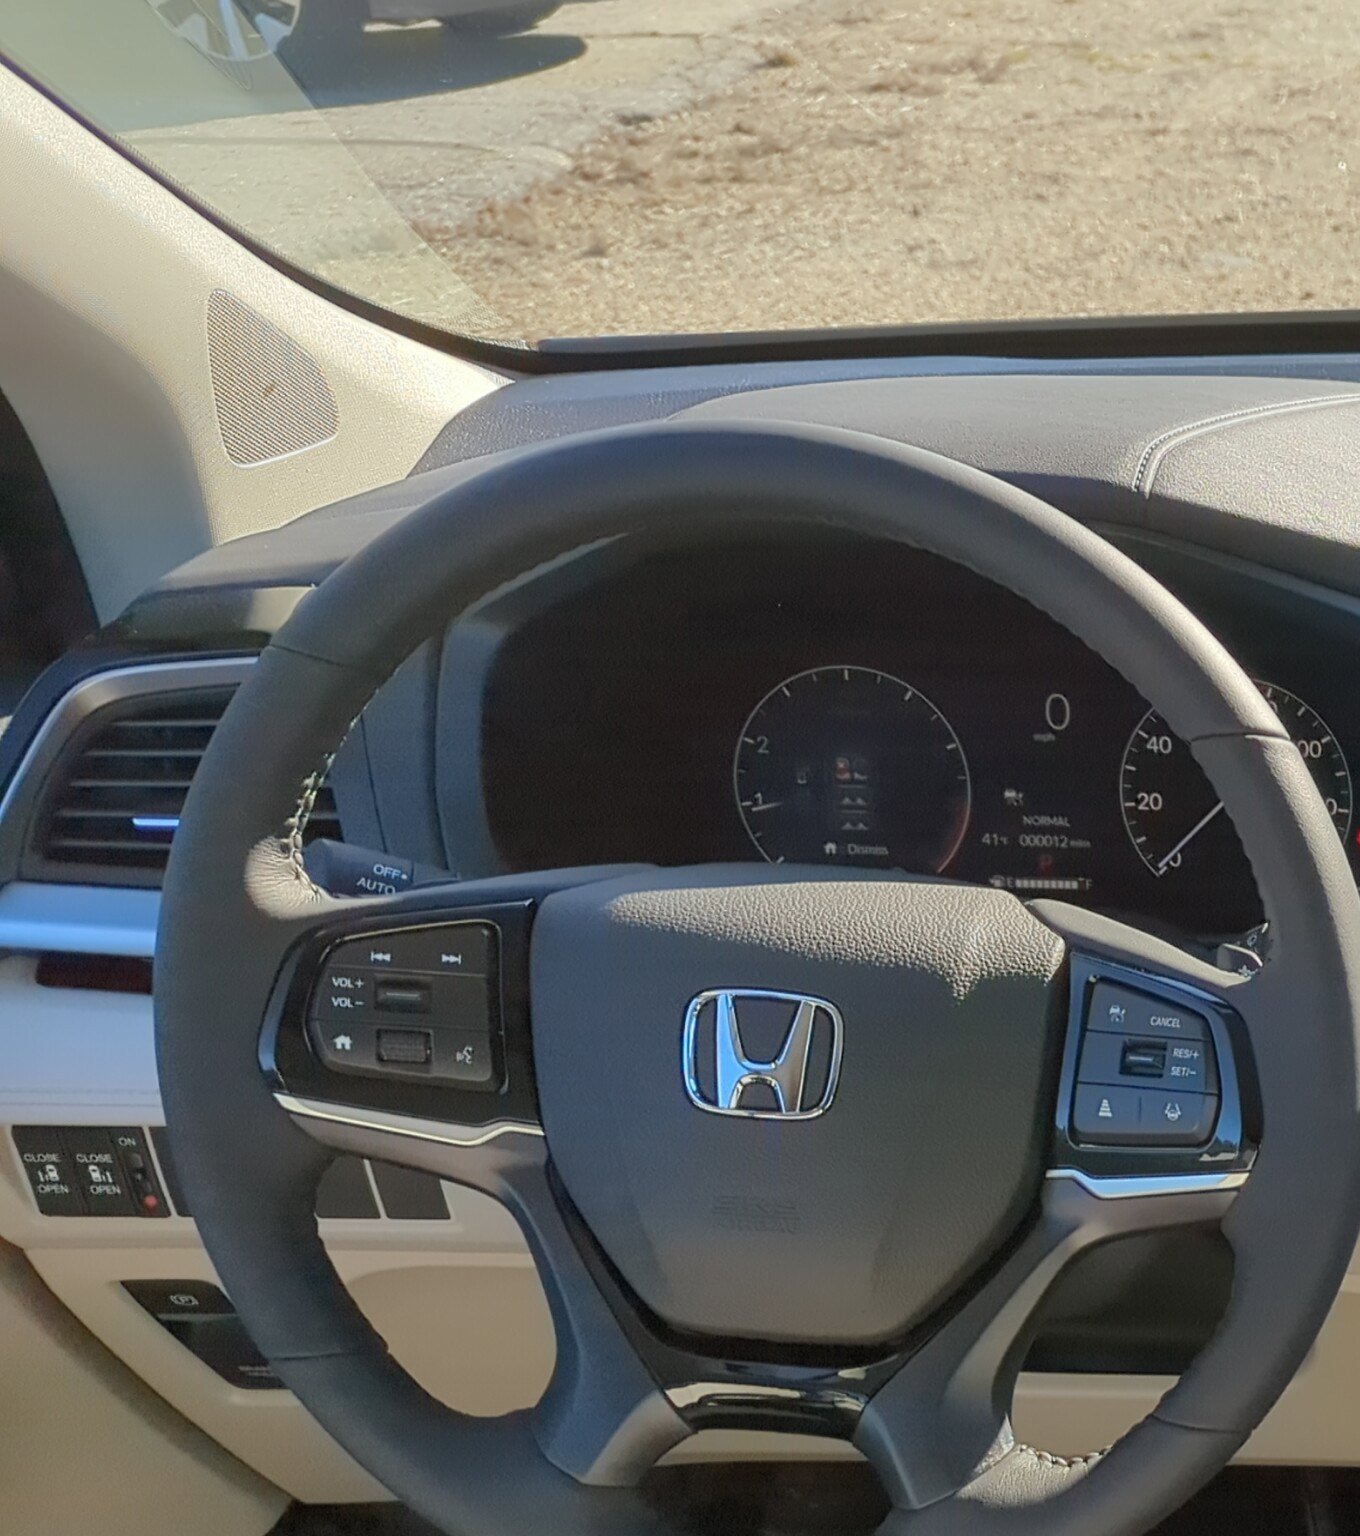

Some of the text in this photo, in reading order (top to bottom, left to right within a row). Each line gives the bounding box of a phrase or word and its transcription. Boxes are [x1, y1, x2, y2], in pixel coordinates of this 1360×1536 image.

[1045, 693, 1070, 730] 0
[757, 736, 769, 754] 2
[1147, 736, 1172, 754] 40
[1297, 740, 1322, 759] 00
[1137, 793, 1162, 811] 20
[1022, 815, 1070, 827] NORMAL
[1019, 834, 1069, 848] 000012
[848, 844, 889, 855] Dismiss
[373, 864, 400, 879] OFF
[357, 877, 396, 895] AUTO
[1150, 1016, 1181, 1028] CANCEL
[118, 1137, 136, 1146] ON
[24, 1153, 61, 1163] CLOSE
[76, 1153, 113, 1163] CLOSE
[38, 1185, 69, 1194] OPEN
[90, 1185, 121, 1194] OPEN
